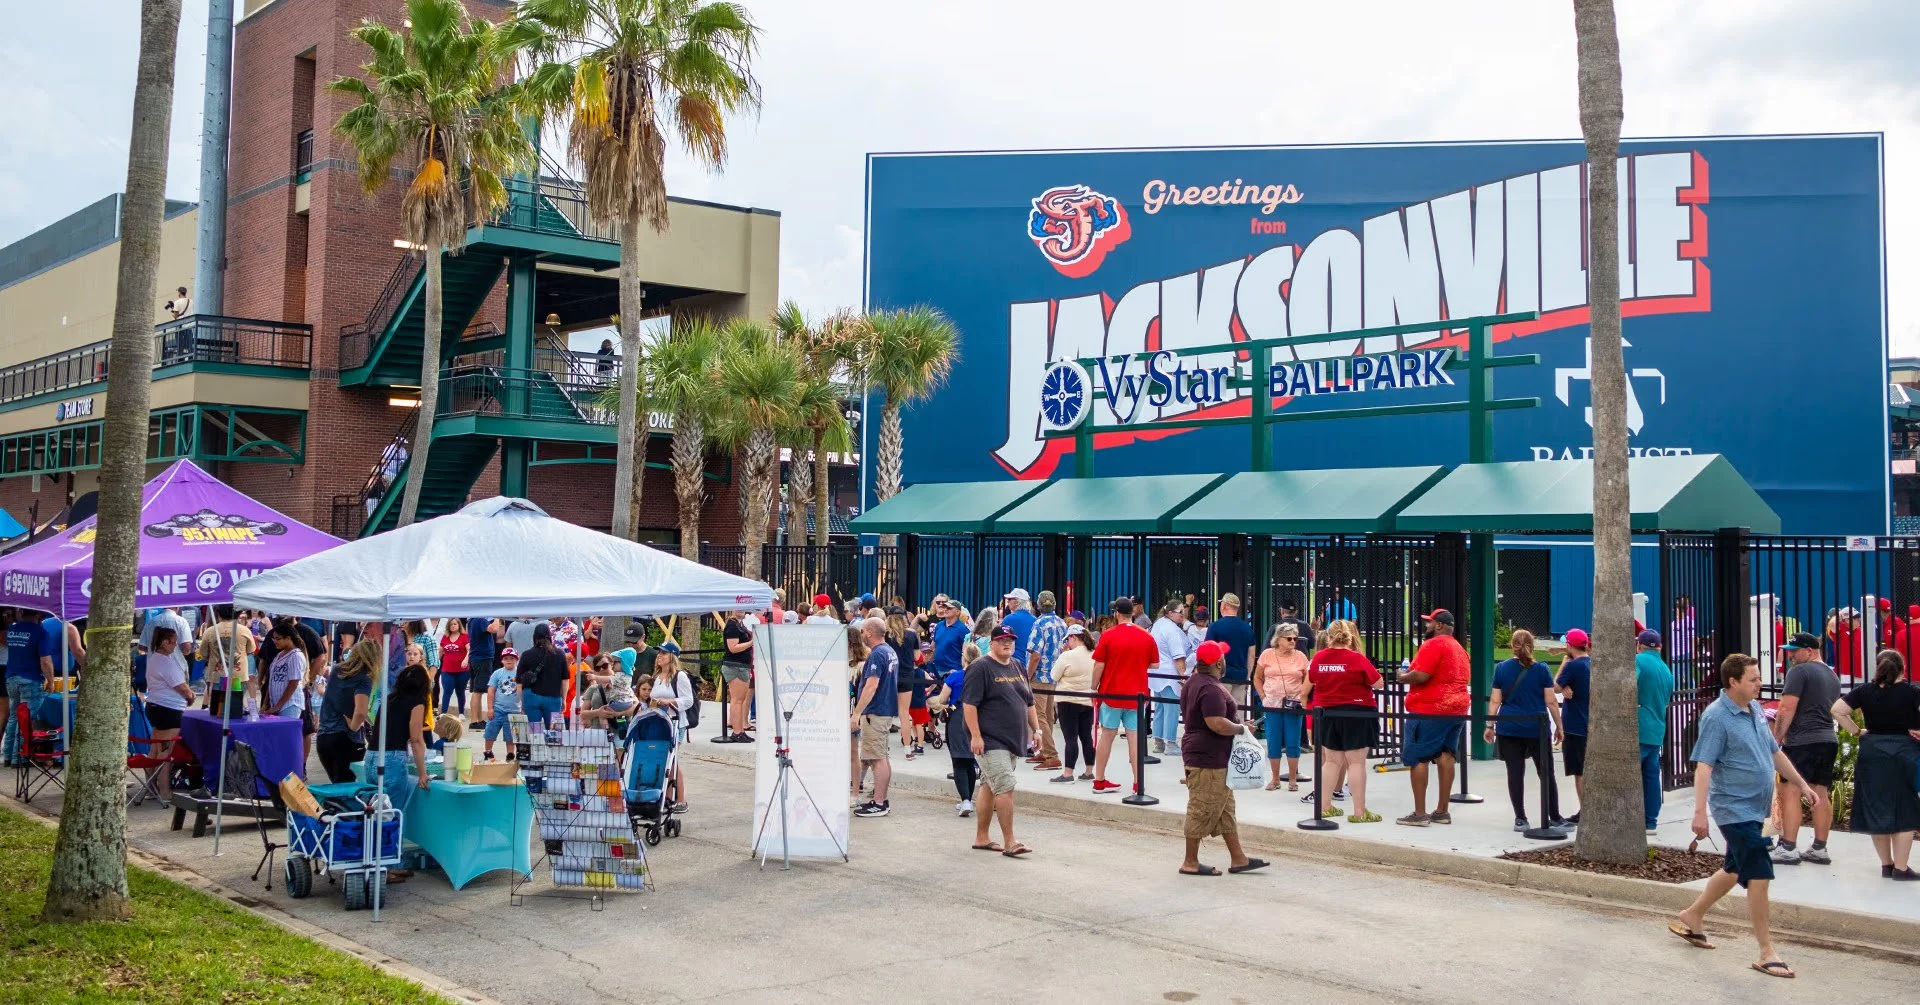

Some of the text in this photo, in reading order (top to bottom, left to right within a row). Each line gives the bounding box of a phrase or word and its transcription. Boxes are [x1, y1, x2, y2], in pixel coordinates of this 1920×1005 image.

[1143, 178, 1305, 215] Greetings
[1250, 217, 1287, 235] from
[992, 150, 1696, 476] JACKSONVILE
[1098, 350, 1455, 424] VyStar BALLPARK
[195, 568, 222, 595] @
